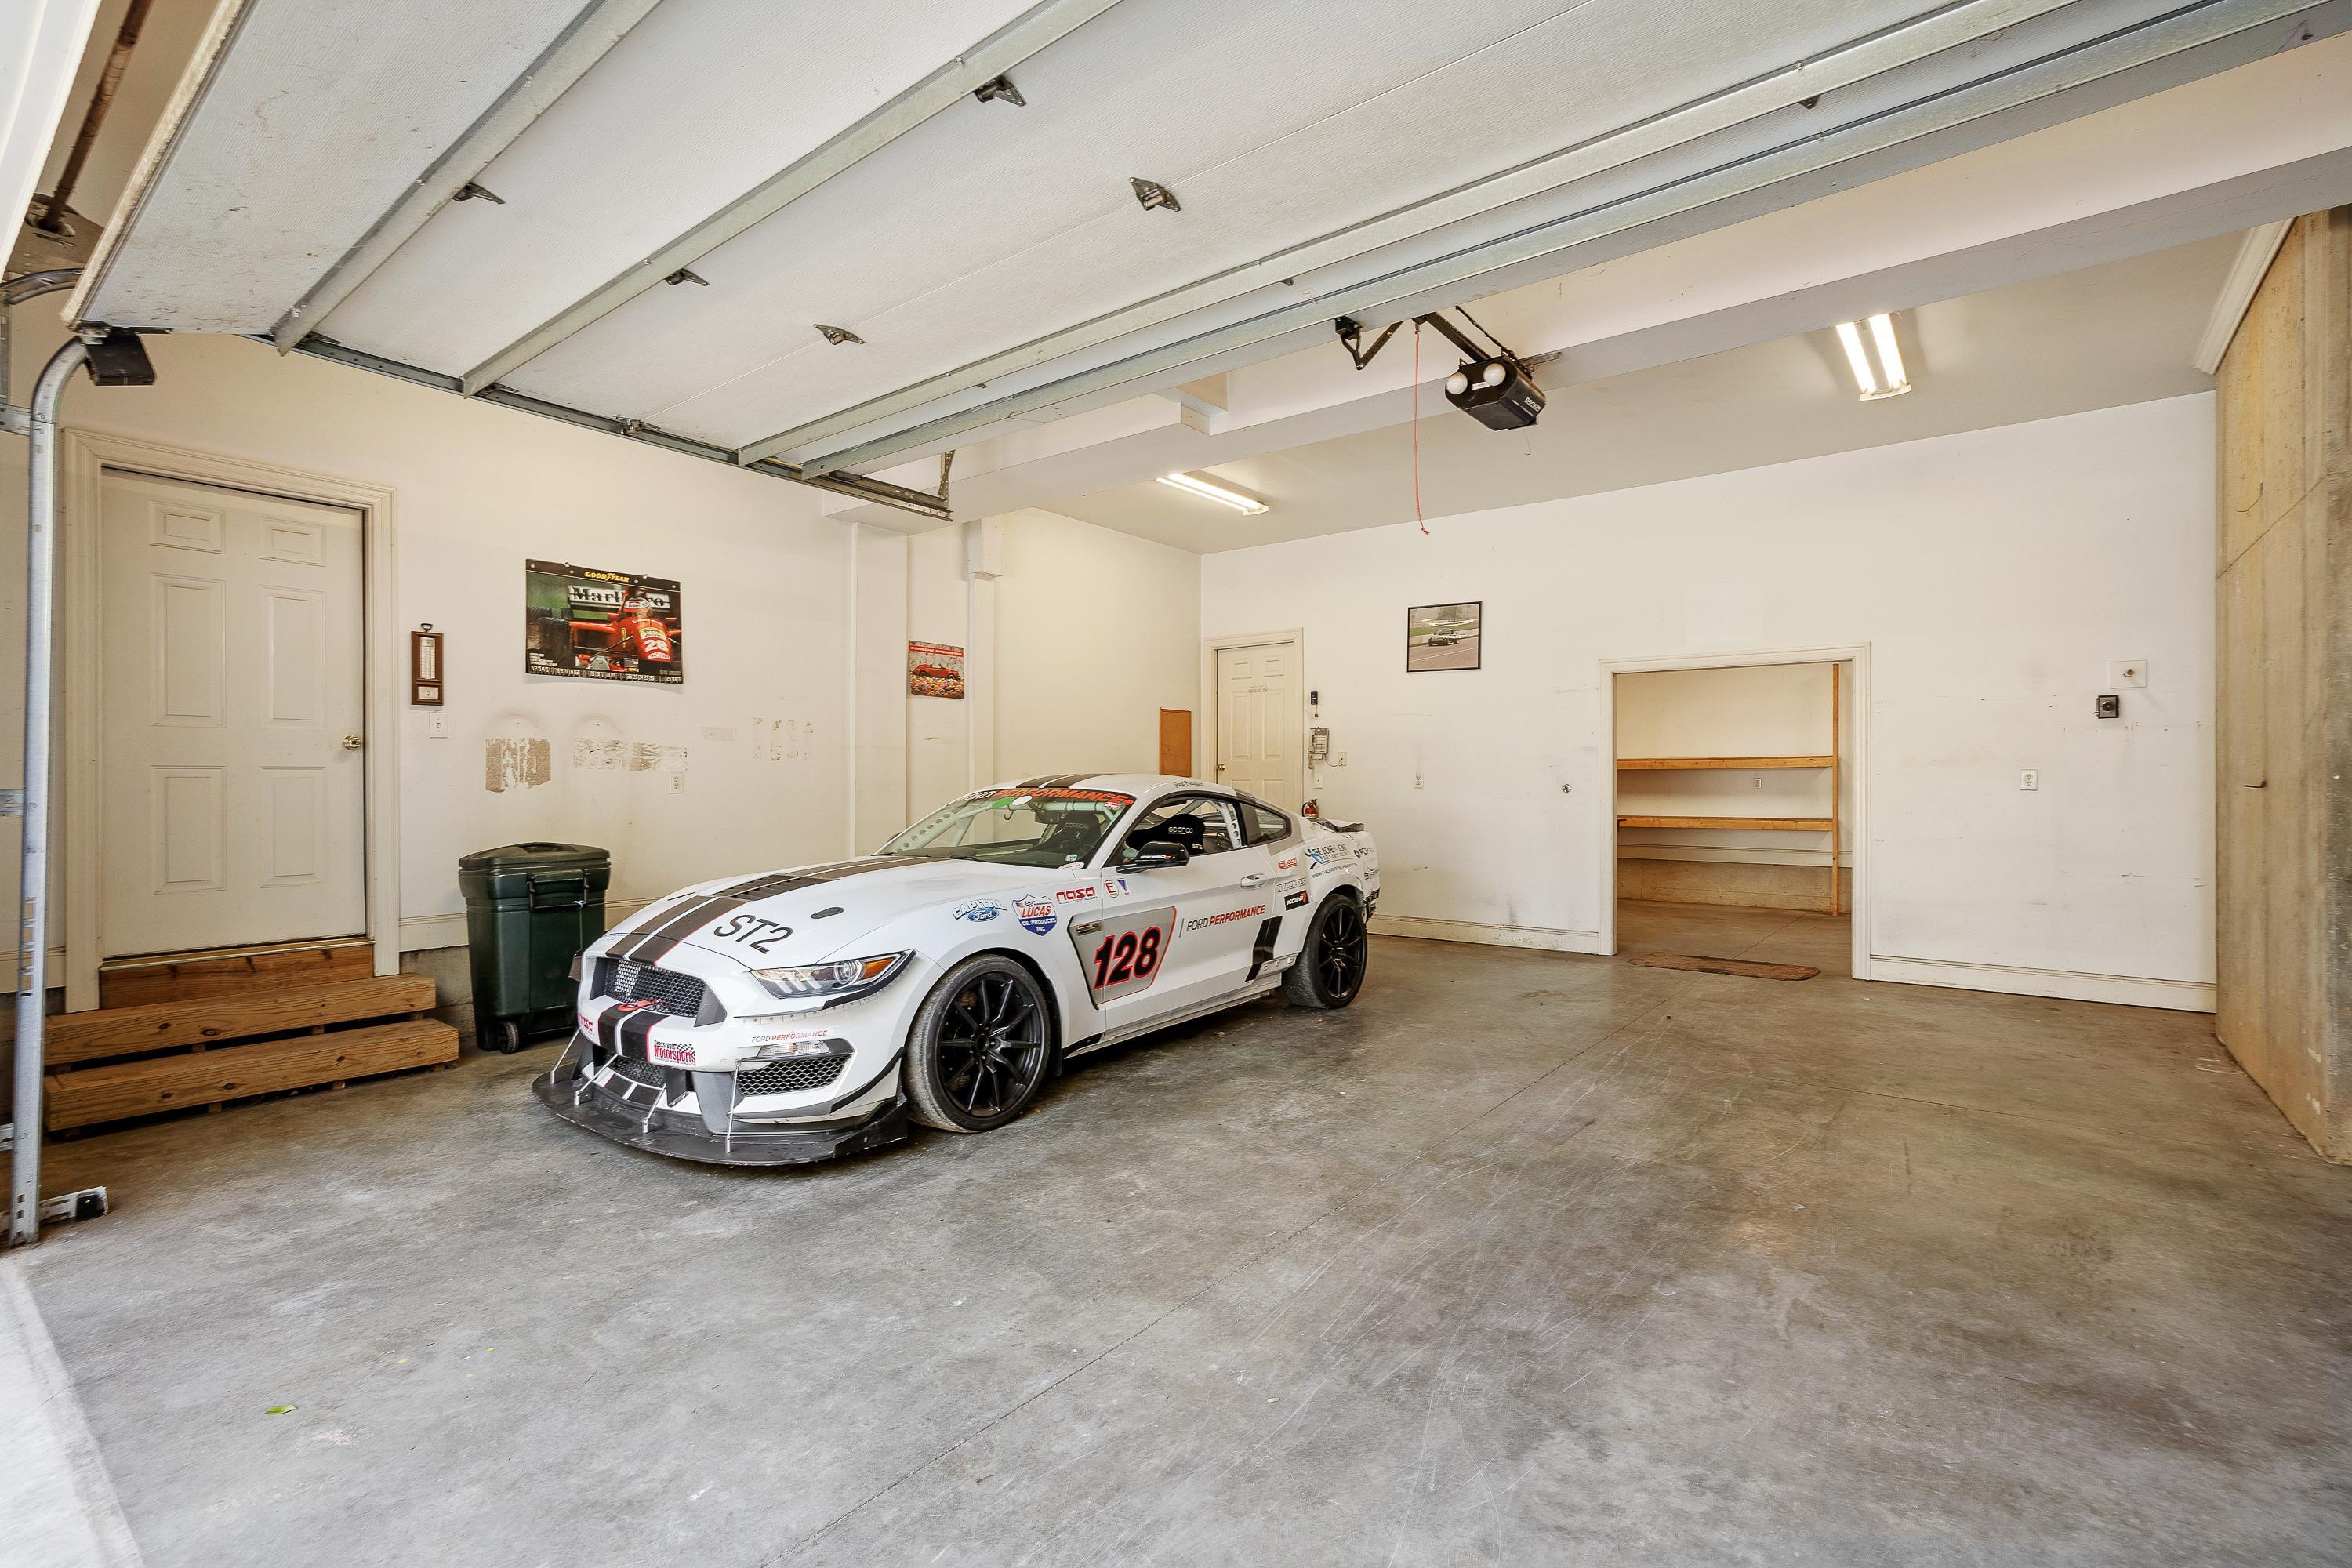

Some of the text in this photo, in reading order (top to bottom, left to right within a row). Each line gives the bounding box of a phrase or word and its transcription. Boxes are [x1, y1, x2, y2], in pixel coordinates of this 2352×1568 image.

[584, 571, 630, 583] GOODYEAR
[572, 586, 665, 607] Marlro
[992, 789, 1130, 804] PERFORMANCE
[1055, 887, 1096, 902] nasa
[1105, 882, 1117, 895] E
[1286, 892, 1307, 906] KONI
[953, 899, 1007, 920] CAPITAL
[973, 910, 994, 920] Ford
[1021, 905, 1052, 918] LUCAS
[1186, 904, 1266, 932] FORD PERFORMANCE
[713, 913, 793, 955] ST2
[1093, 925, 1162, 991] 128
[771, 1029, 828, 1041] PERFORMANCE
[654, 1044, 696, 1064] Motorsports
